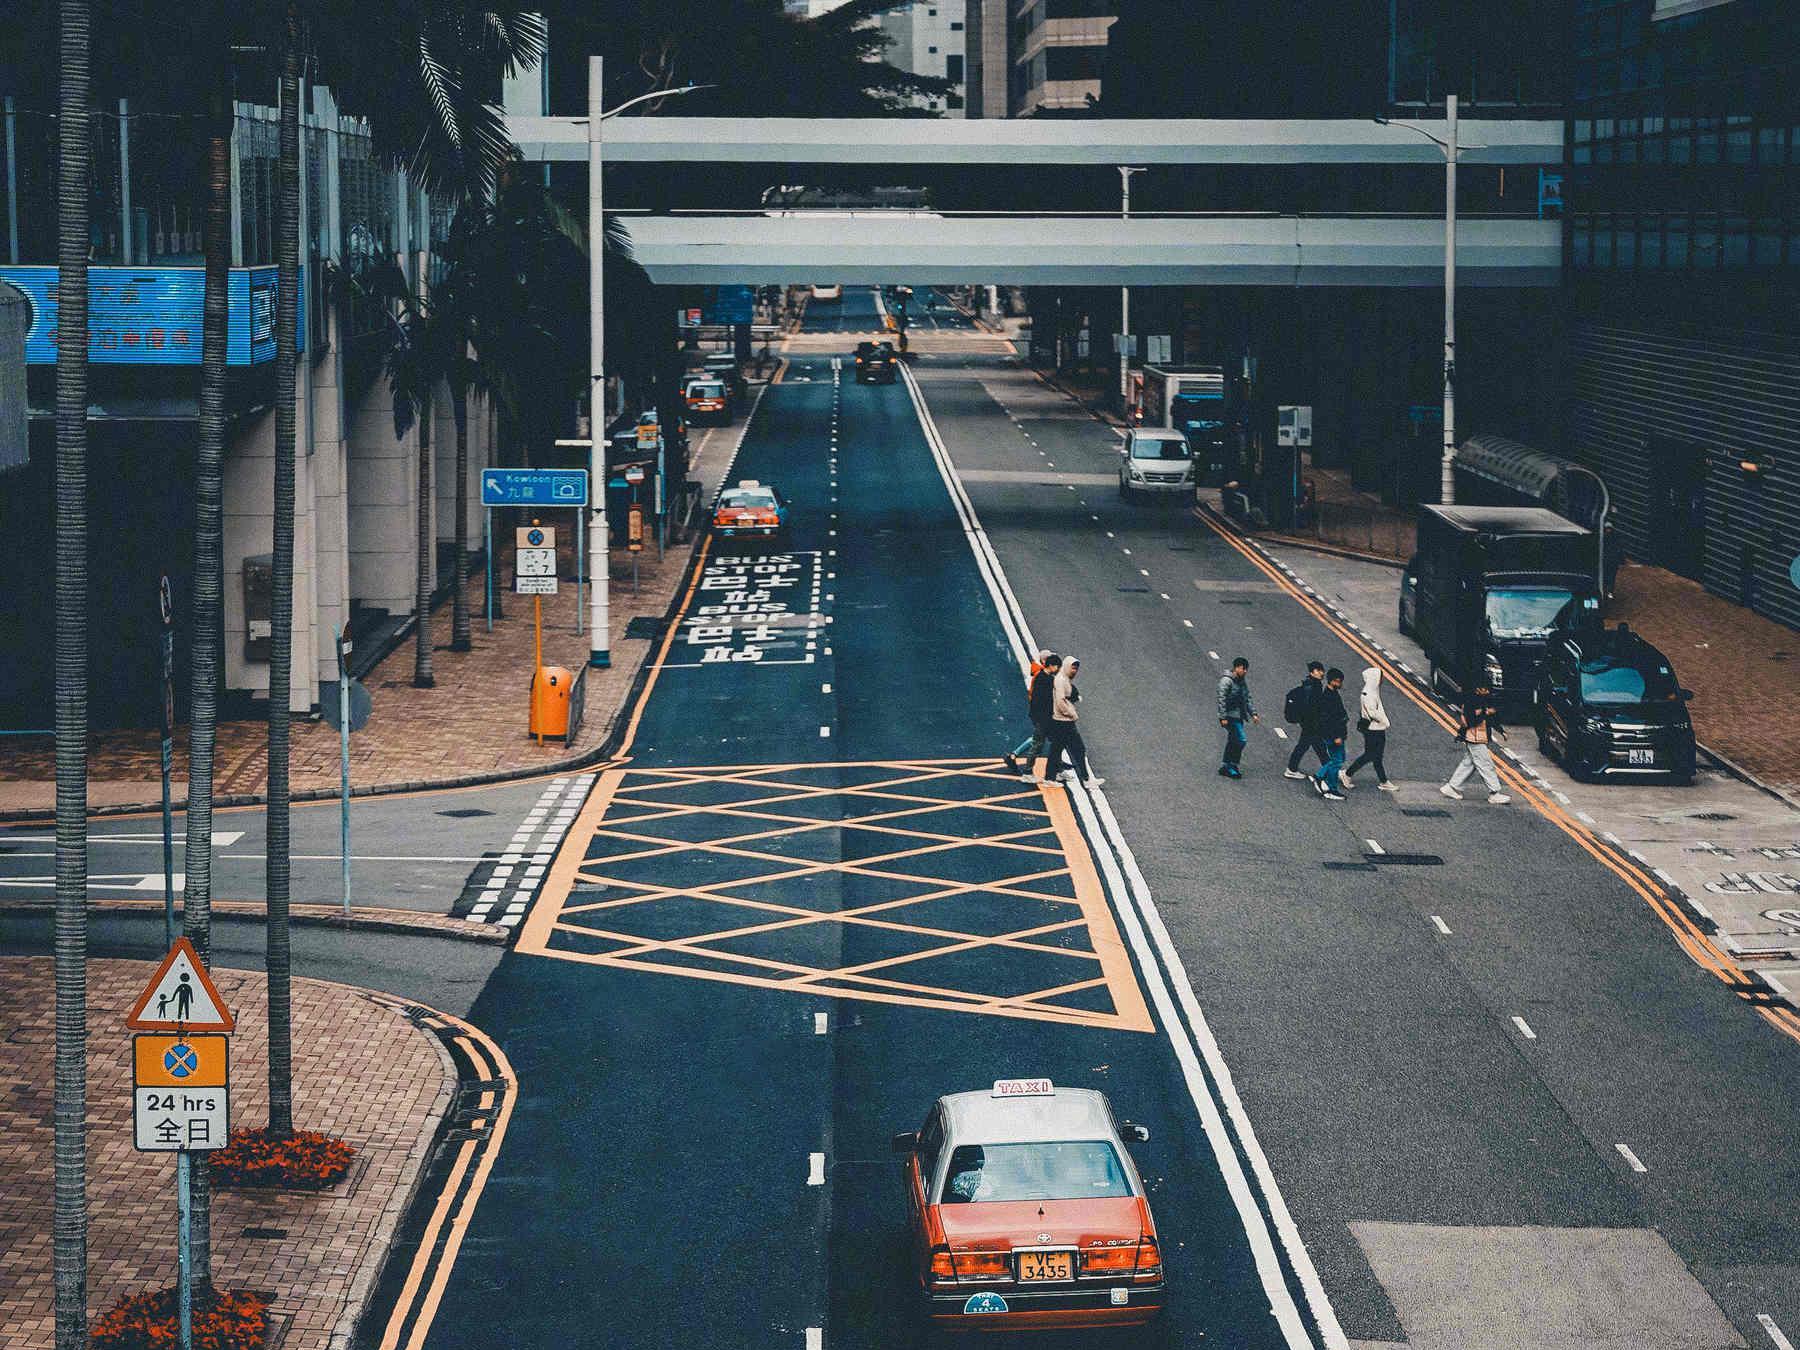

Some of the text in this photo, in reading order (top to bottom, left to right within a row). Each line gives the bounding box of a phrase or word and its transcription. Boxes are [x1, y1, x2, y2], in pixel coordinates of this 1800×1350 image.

[506, 475, 552, 483] Kowloon
[715, 555, 794, 565] BUS
[704, 564, 802, 575] STOP
[700, 575, 799, 590] 巴士
[722, 589, 772, 604] 站
[698, 603, 788, 615] BUS
[682, 612, 796, 626] STOP
[687, 625, 784, 645] 巴士
[700, 645, 763, 663] 站
[998, 1081, 1049, 1094] TAXI
[147, 1094, 216, 1112] 24 hrs
[154, 1117, 210, 1144] 全日
[1025, 1265, 1067, 1279] 3435
